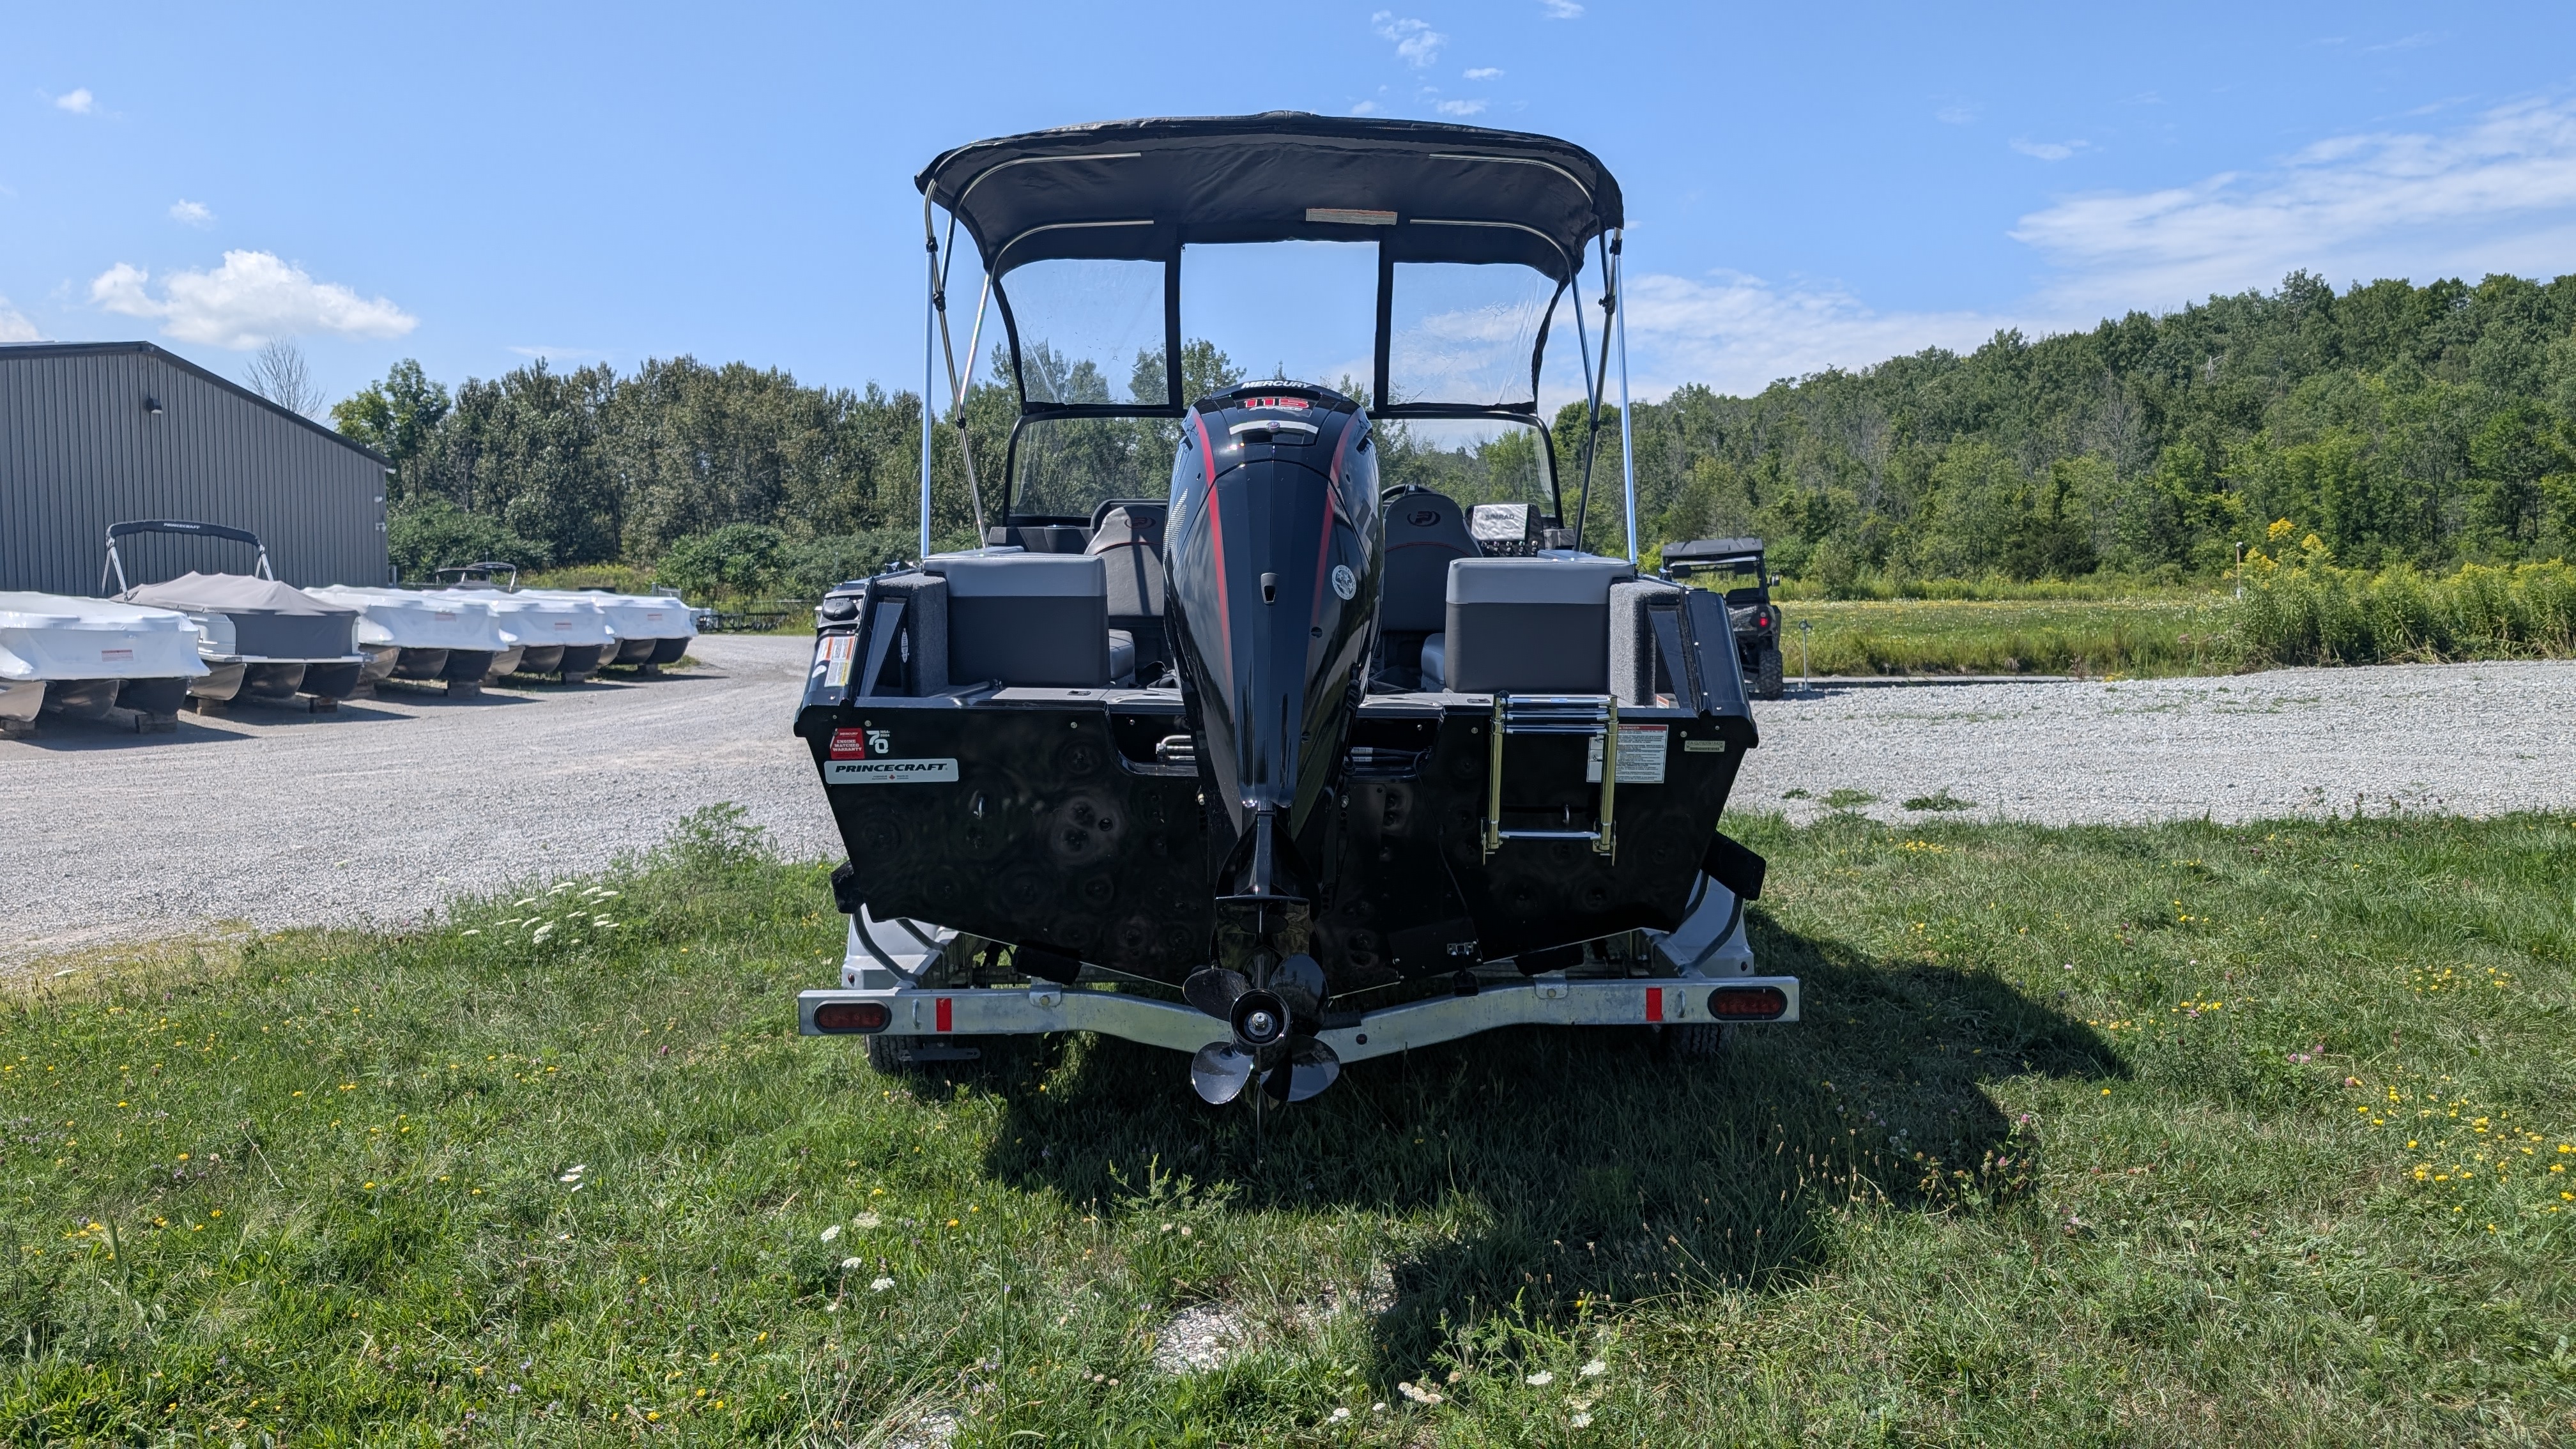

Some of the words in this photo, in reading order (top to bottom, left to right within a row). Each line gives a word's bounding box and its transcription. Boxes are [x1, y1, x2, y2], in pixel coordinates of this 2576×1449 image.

[1241, 381, 1312, 389] MERCURY
[1244, 398, 1309, 408] 115
[835, 763, 947, 772] PRINCECRAFT
